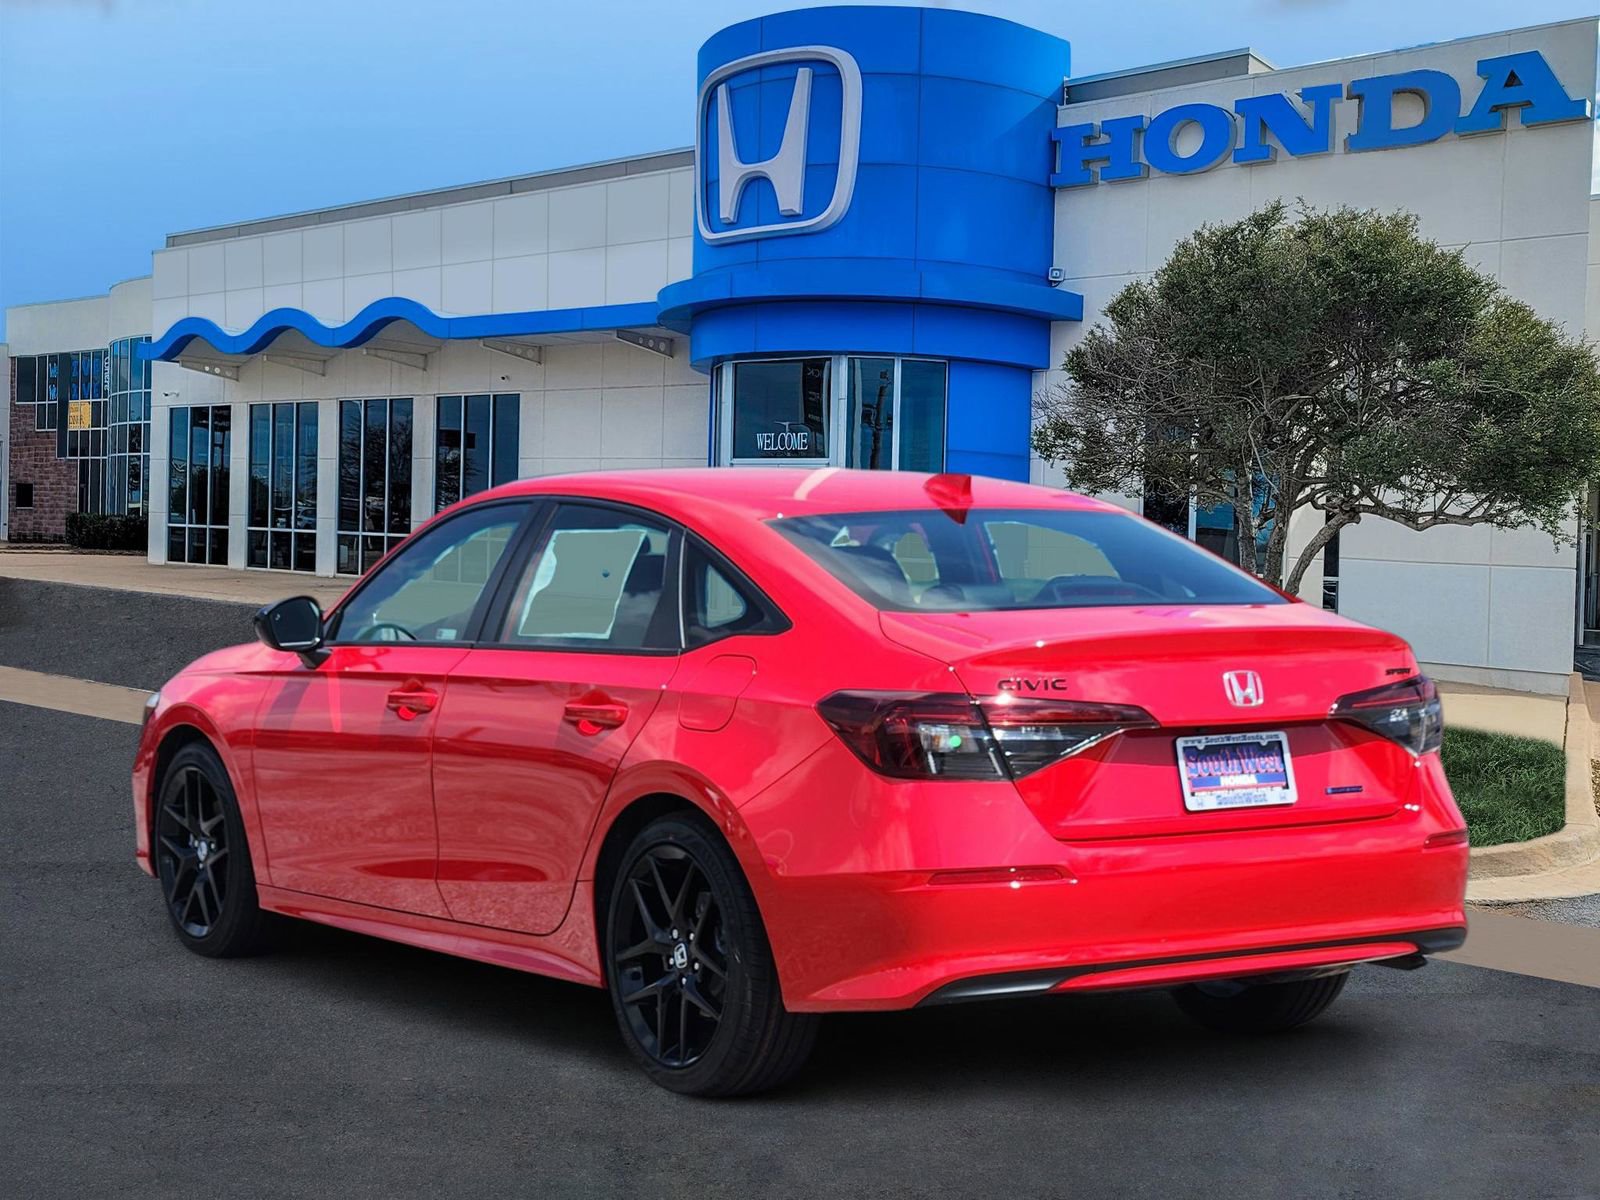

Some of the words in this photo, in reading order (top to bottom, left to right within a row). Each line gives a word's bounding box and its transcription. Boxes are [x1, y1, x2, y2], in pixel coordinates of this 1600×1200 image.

[1051, 50, 1591, 188] HONDA
[756, 432, 809, 451] WELCOME
[997, 678, 1068, 691] CIVIC
[1185, 747, 1285, 779] SouthWest
